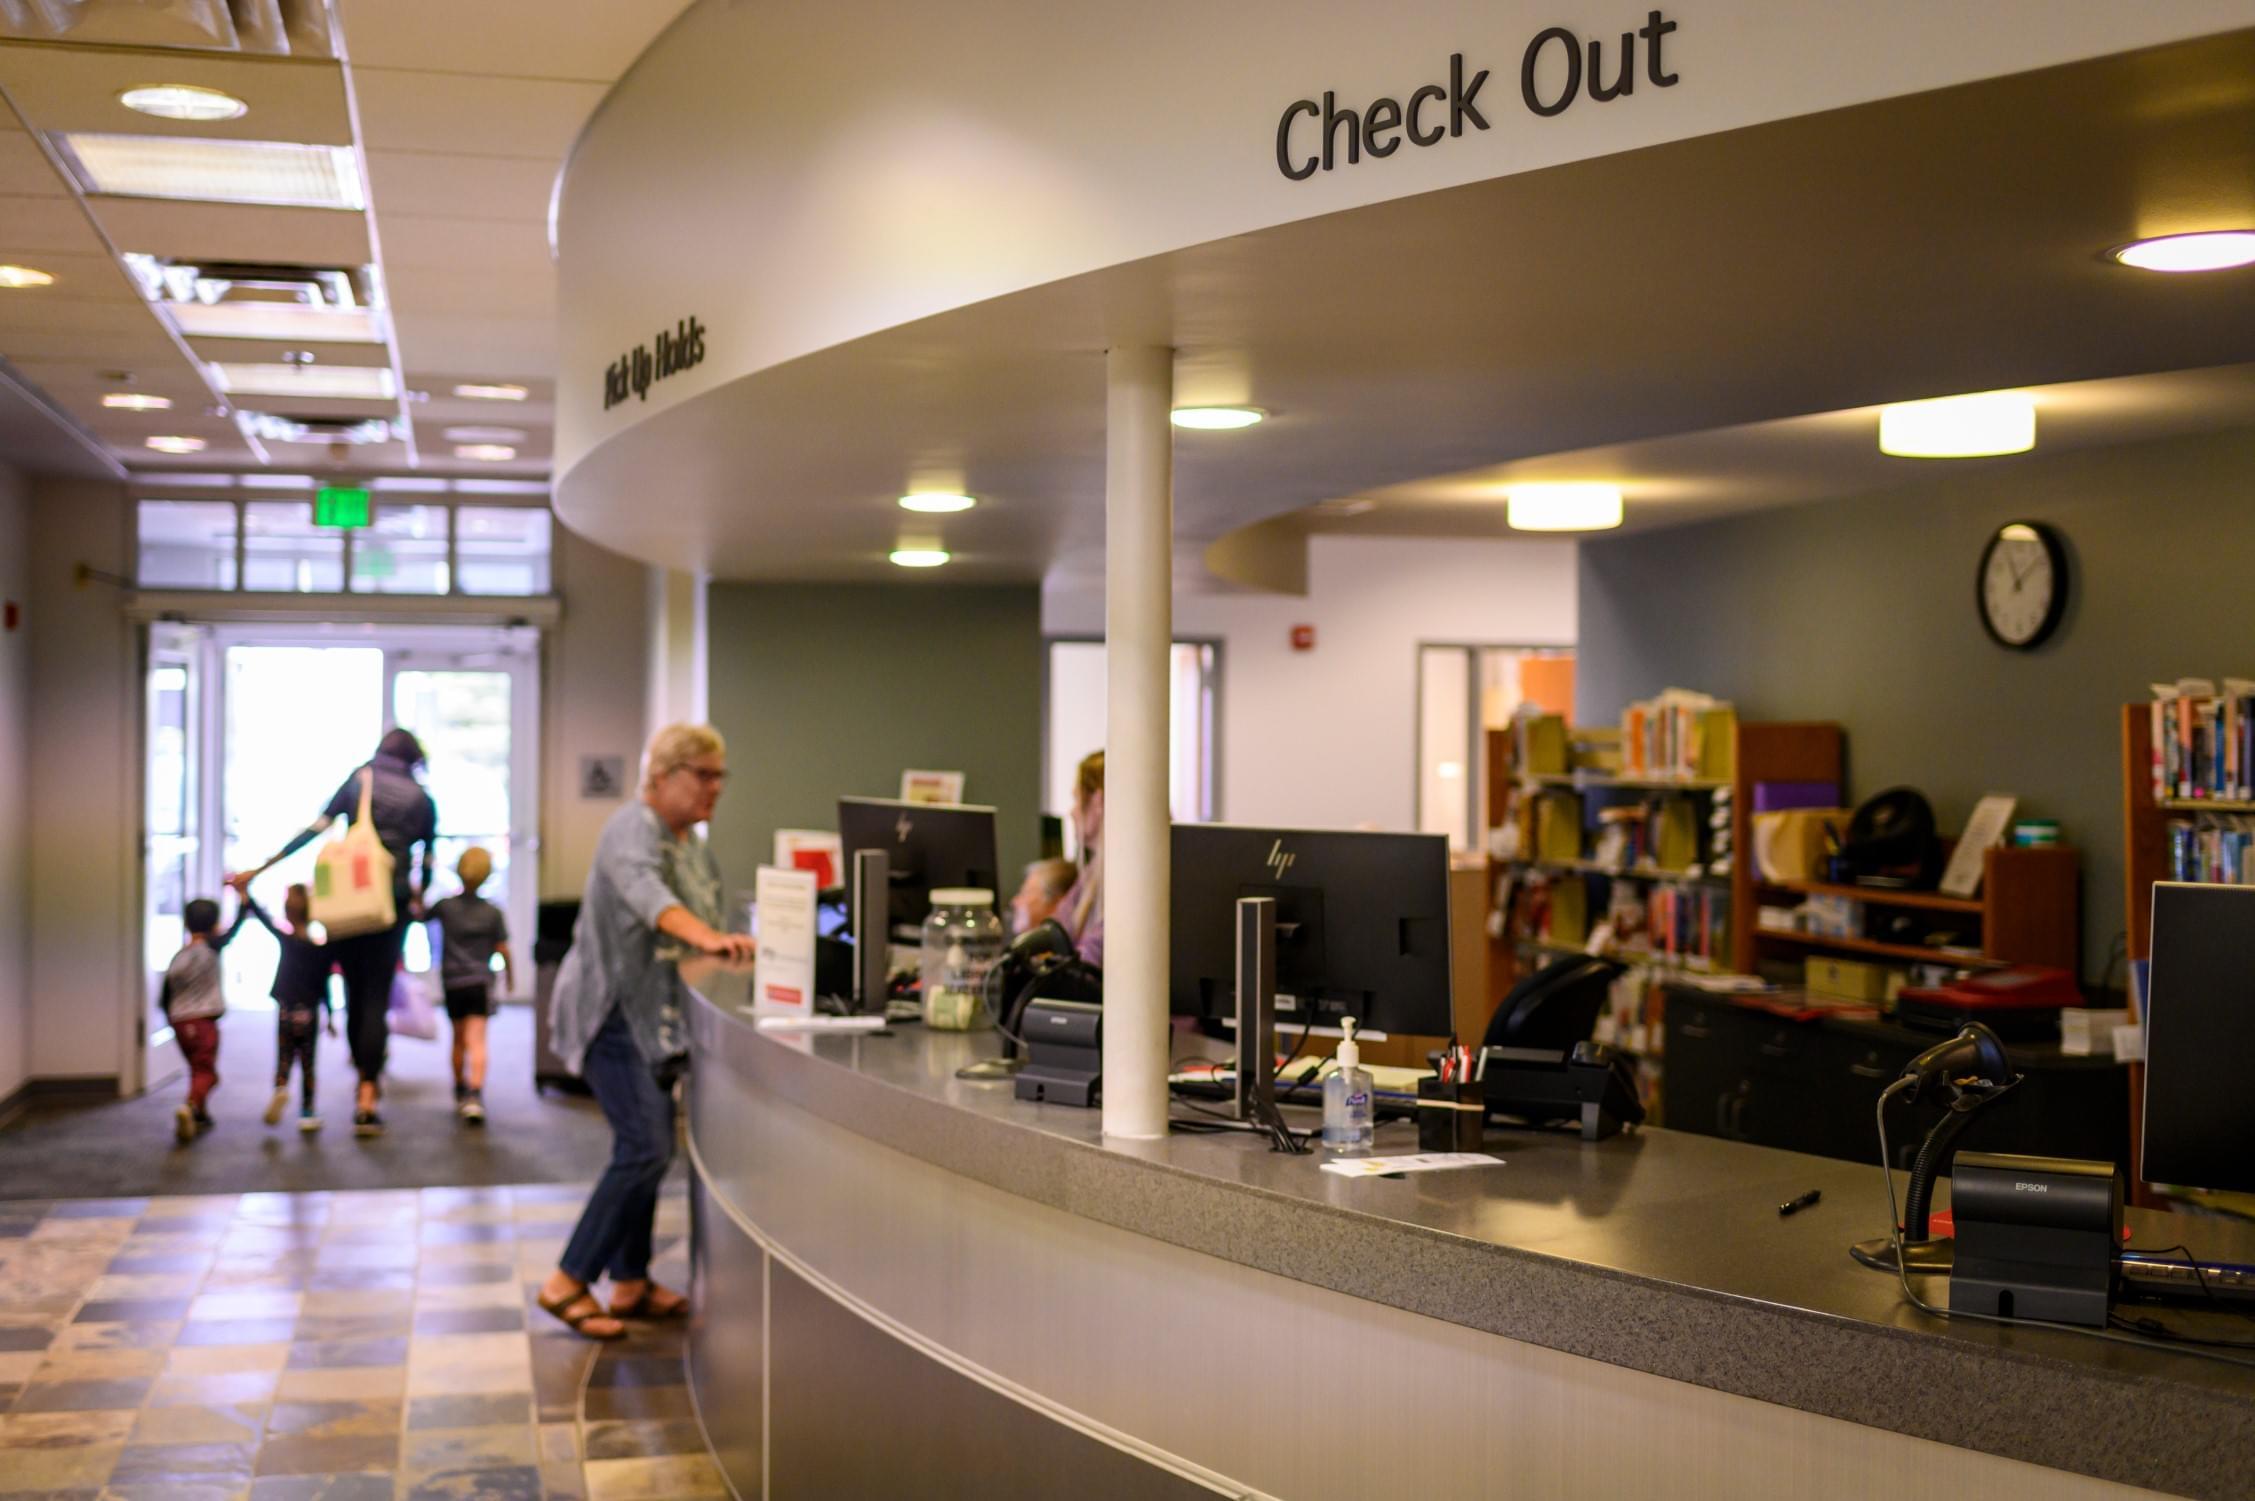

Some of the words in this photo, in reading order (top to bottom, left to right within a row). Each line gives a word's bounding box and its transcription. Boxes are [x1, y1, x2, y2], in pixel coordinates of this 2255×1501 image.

[1276, 53, 1490, 182] Check
[1521, 10, 1679, 118] Out
[2015, 1182, 2048, 1193] EPSON
